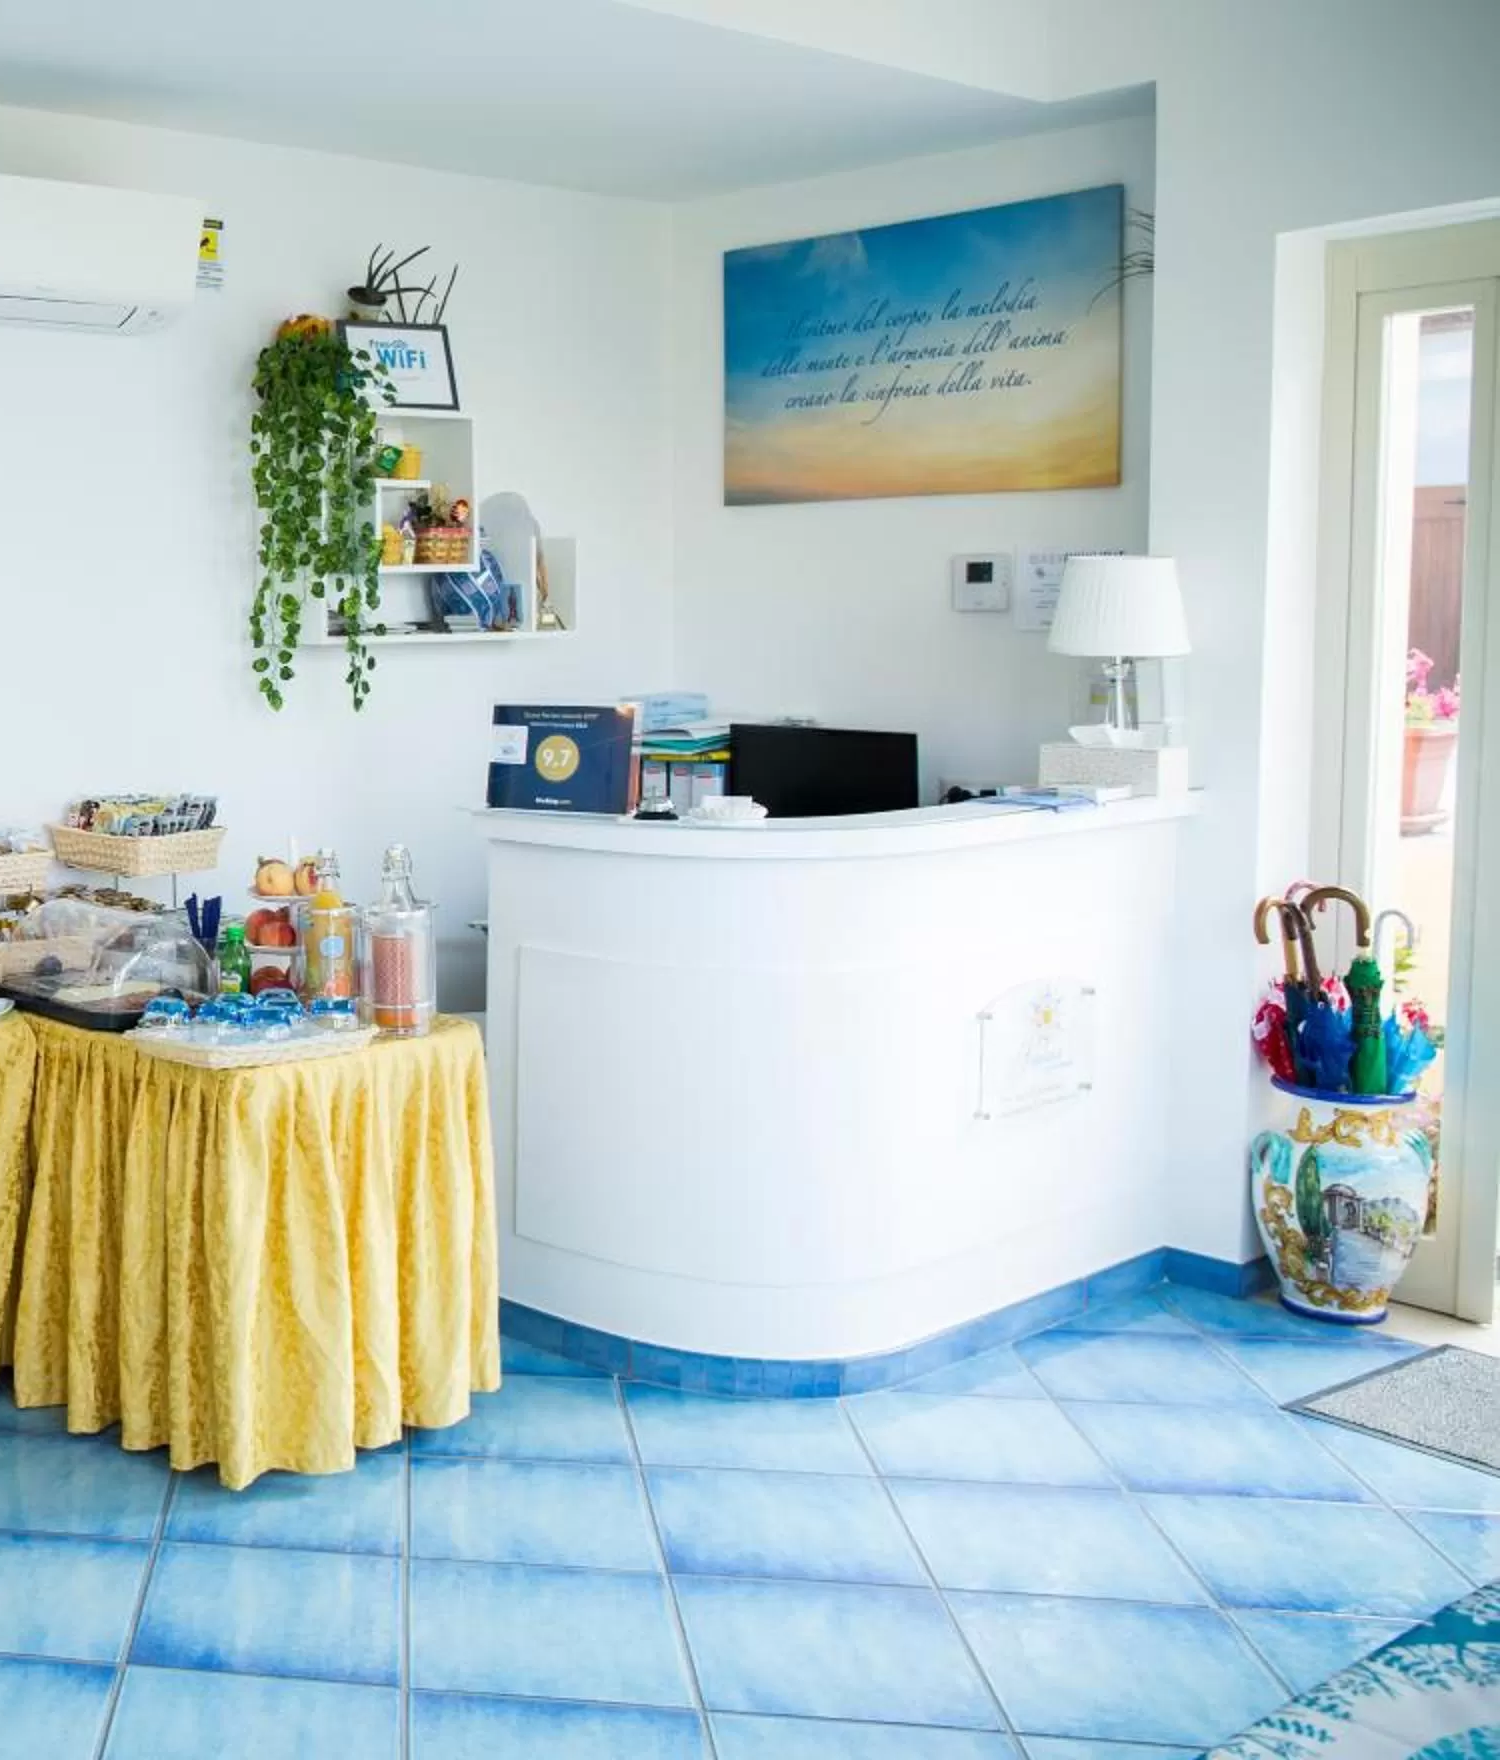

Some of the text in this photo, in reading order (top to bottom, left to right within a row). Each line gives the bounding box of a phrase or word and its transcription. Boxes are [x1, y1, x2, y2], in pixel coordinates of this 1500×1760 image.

[853, 298, 890, 333] del
[941, 287, 962, 321] la
[966, 276, 1038, 318] melodia
[760, 346, 802, 378] della
[805, 352, 851, 372] mente
[854, 354, 865, 367] e
[784, 391, 835, 409] creano
[839, 372, 860, 403] la
[860, 364, 931, 425] sinfonia
[937, 359, 985, 396] della
